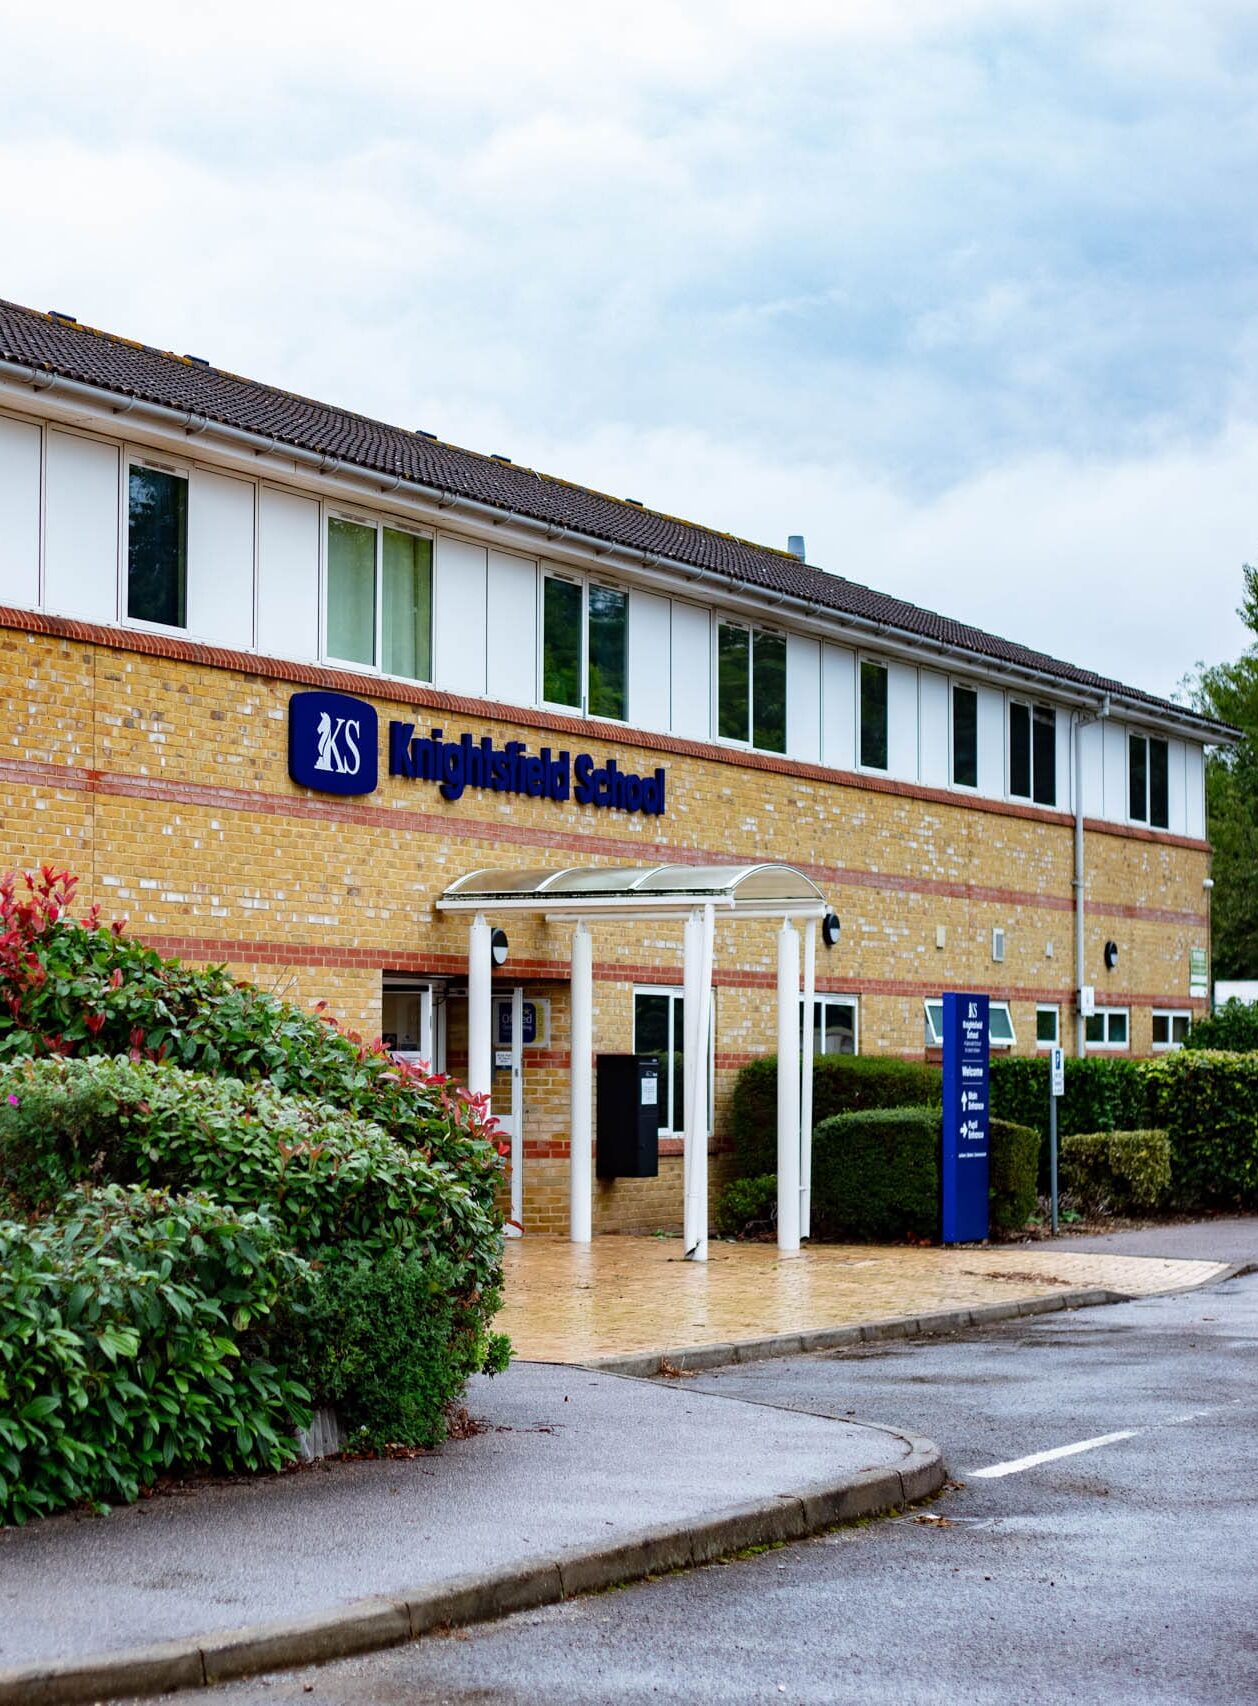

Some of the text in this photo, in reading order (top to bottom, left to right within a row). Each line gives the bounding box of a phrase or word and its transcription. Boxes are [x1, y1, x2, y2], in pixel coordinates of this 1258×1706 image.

[314, 712, 361, 776] KS
[389, 721, 666, 816] Knightsfield School
[961, 1065, 983, 1077] Welcome
[968, 1101, 984, 1111] Entrance
[968, 1119, 978, 1131] Pupil
[968, 1130, 984, 1139] Entrance
